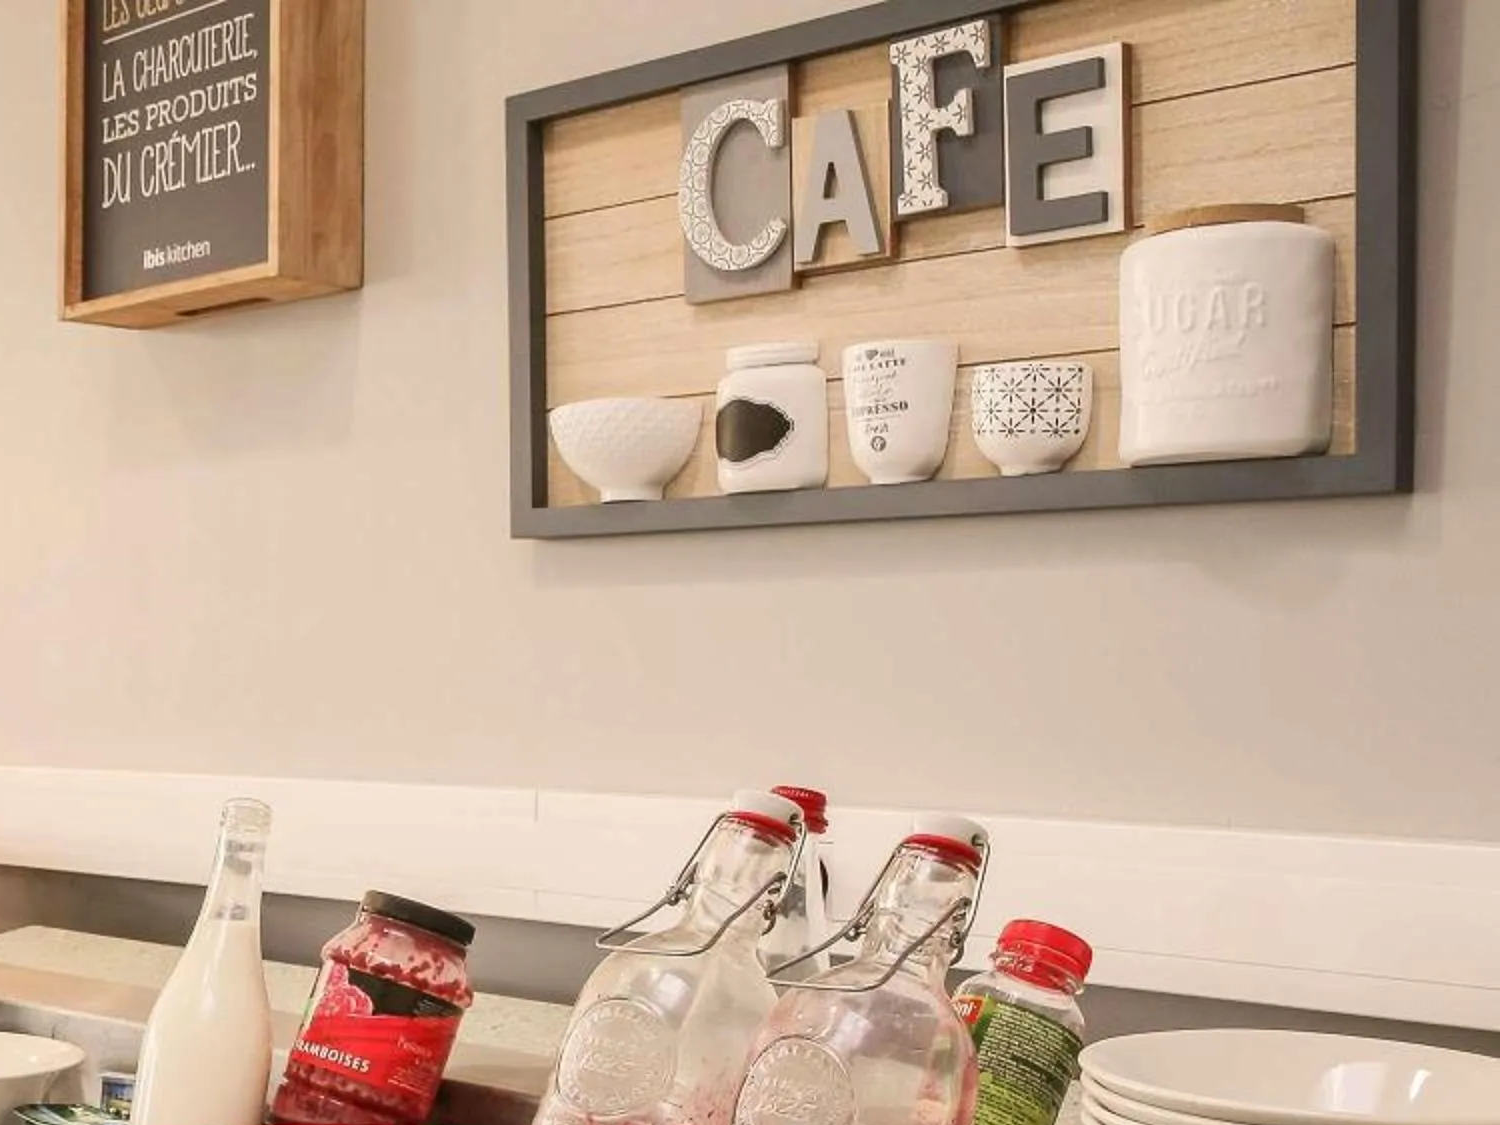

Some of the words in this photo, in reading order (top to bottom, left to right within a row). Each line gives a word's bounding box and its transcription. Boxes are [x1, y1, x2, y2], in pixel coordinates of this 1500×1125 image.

[102, 59, 126, 103] LA
[102, 109, 139, 144] LES
[145, 72, 258, 131] PRODUITS
[678, 19, 1110, 273] CAFE
[102, 152, 131, 209] DU
[143, 247, 165, 270] ibis
[166, 239, 211, 265] kitchen
[1135, 281, 1268, 336] UGAR
